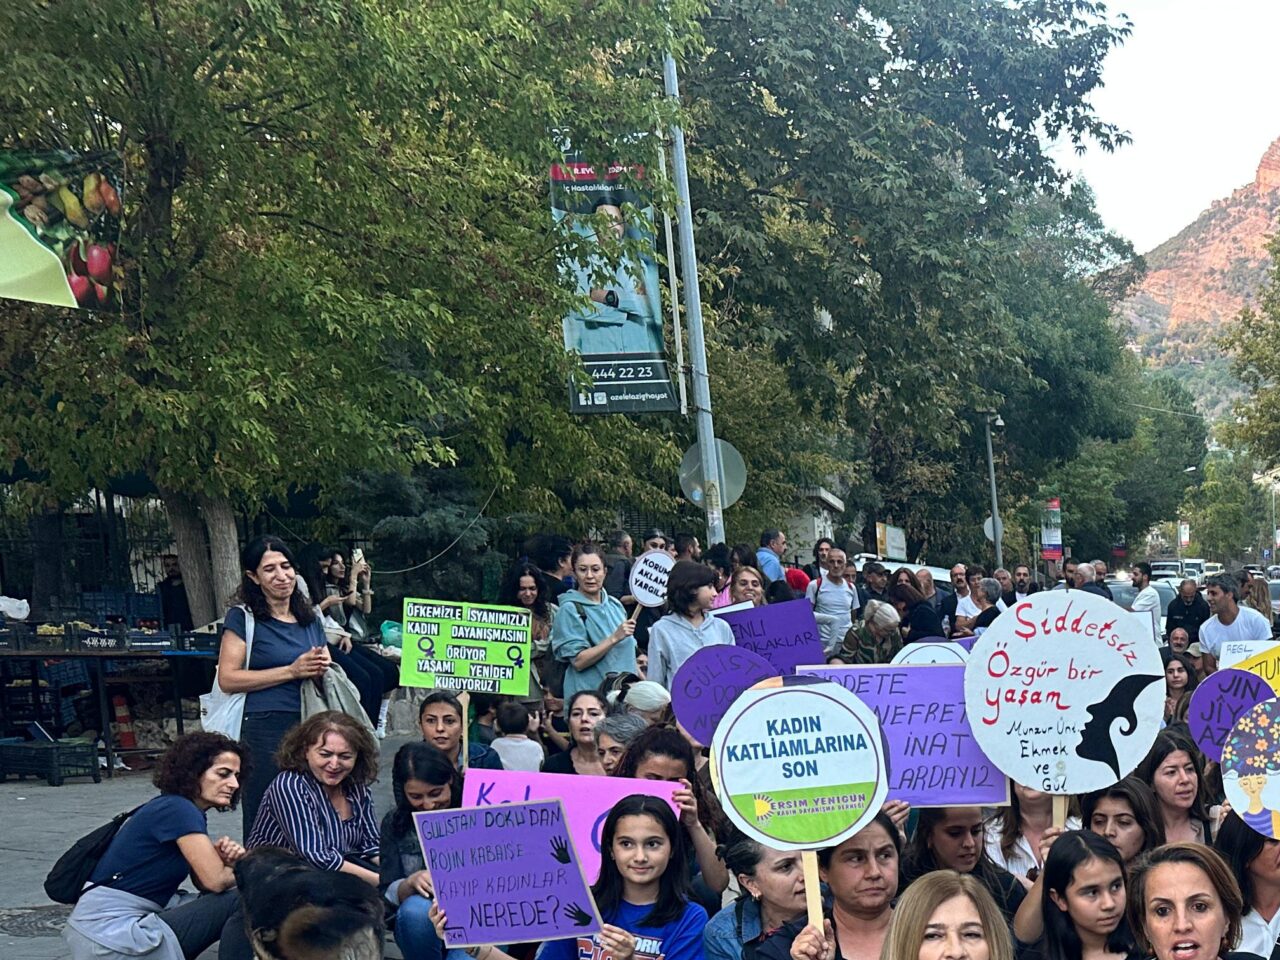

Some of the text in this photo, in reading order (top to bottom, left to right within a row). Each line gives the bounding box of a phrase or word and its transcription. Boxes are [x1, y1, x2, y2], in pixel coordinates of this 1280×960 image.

[592, 367, 653, 379] 444 22 23
[643, 558, 670, 576] KORUM
[638, 568, 668, 587] AKLAM
[634, 578, 667, 599] YARGILA
[407, 603, 528, 627] ÖFKEMİZLE İSYANIMIZLA
[407, 621, 527, 642] KADIN DAYANIŞMASINI
[743, 631, 817, 653] OKAKLAR
[446, 645, 486, 661] ÖRÜYOR
[470, 664, 513, 679] YENİDEN
[987, 642, 1103, 686] Özgür bir
[982, 688, 1071, 725] yaşam
[1200, 697, 1243, 724] JÎY
[766, 716, 822, 736] KADIN
[1006, 721, 1053, 735] Munzur
[904, 731, 969, 757] İNAT
[1198, 727, 1230, 746] AZ
[726, 733, 867, 762] KATLİAMLARINA
[1020, 740, 1069, 758] Ekmek
[782, 760, 818, 778] SON
[1033, 764, 1049, 774] ve
[470, 895, 561, 929] NEREDE?
